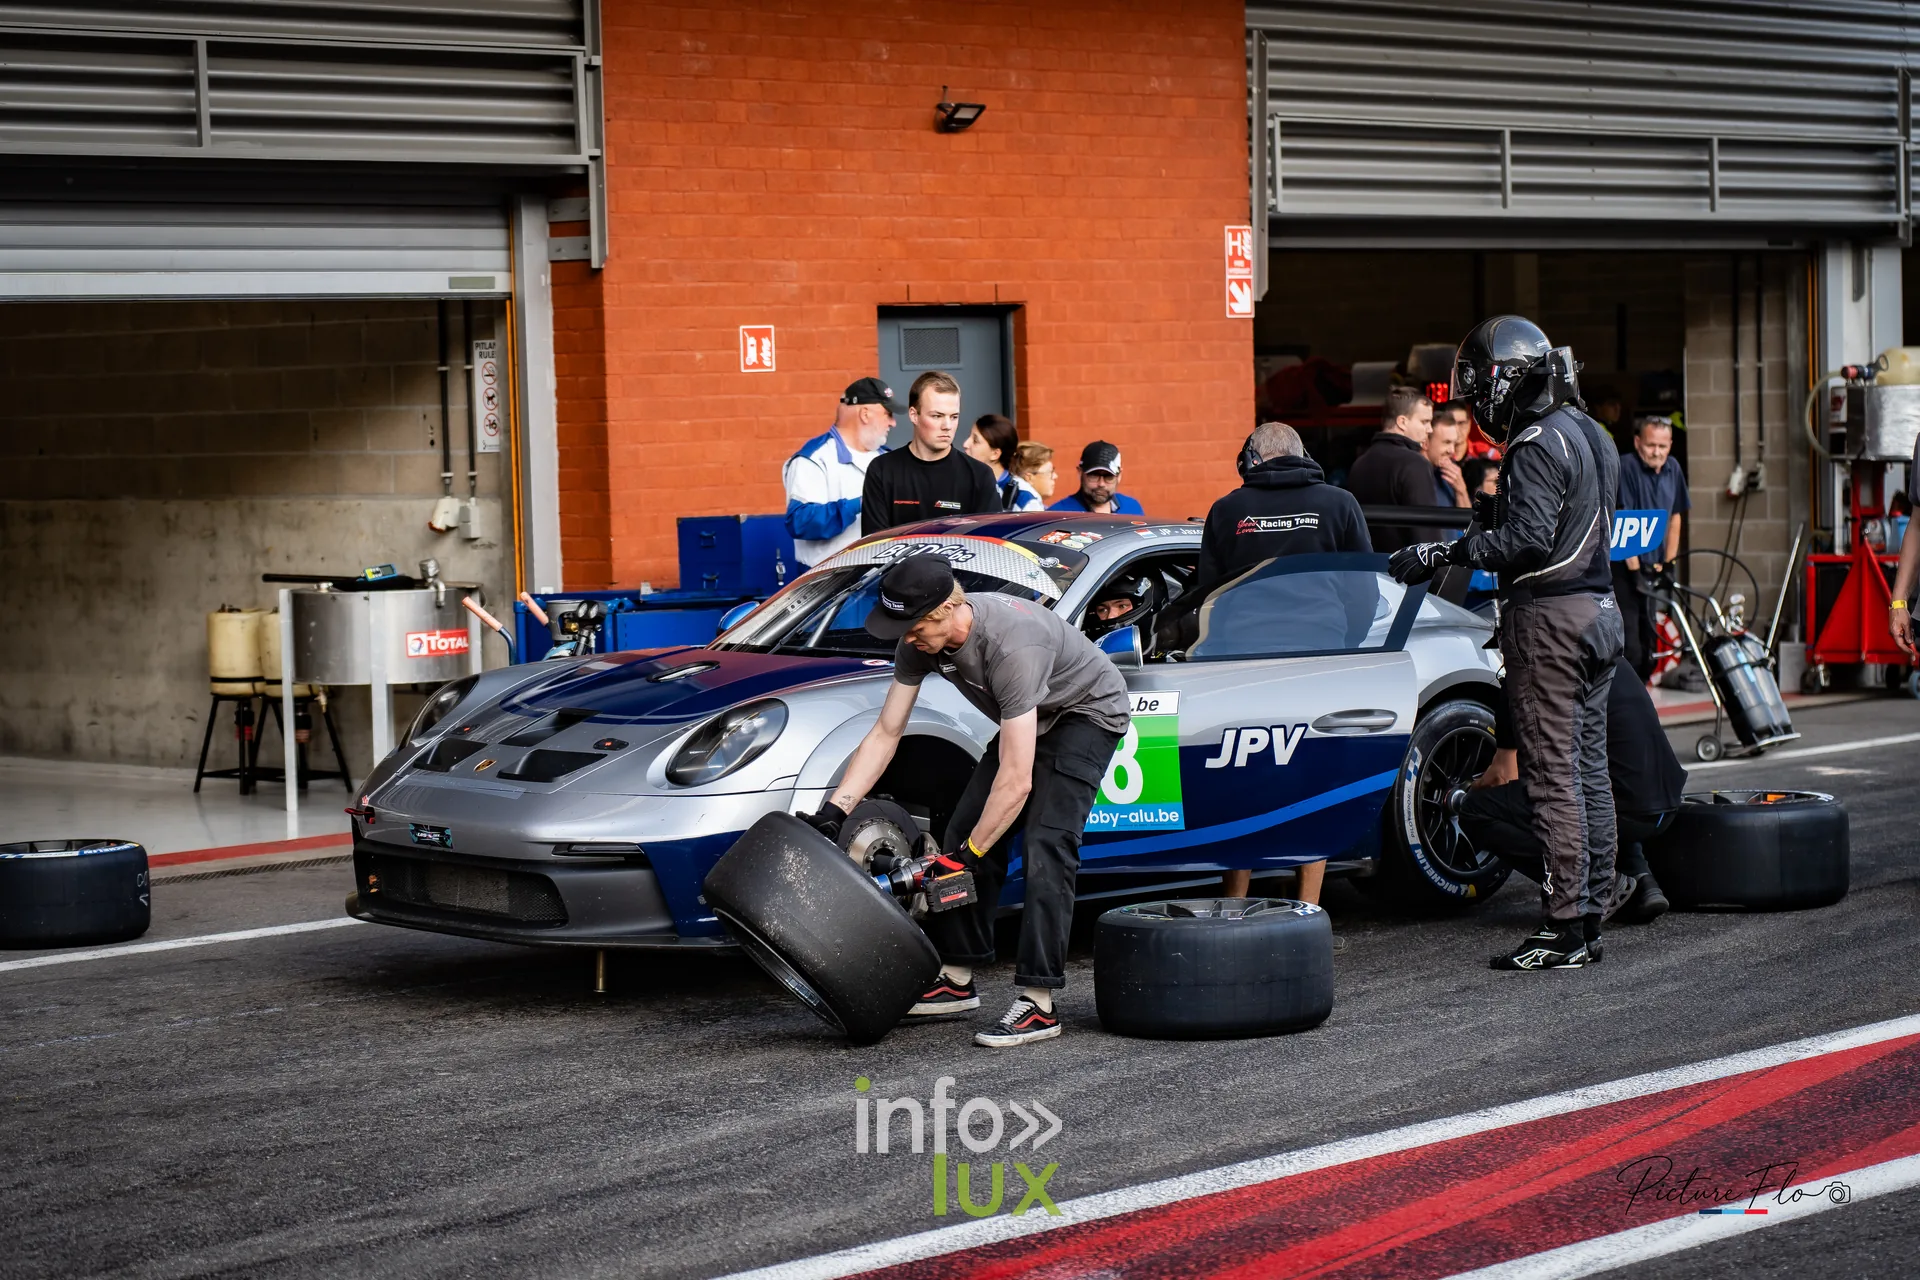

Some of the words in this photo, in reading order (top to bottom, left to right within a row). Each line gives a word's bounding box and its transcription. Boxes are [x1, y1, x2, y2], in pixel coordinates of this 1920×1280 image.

[1158, 528, 1171, 536] JP
[1260, 520, 1292, 529] Racing
[1294, 517, 1319, 526] Team
[1610, 517, 1659, 549] JPV
[1130, 696, 1160, 712] .be
[1094, 720, 1144, 805] 8
[1204, 727, 1306, 769] JPV
[1414, 848, 1458, 895] MICHELIN
